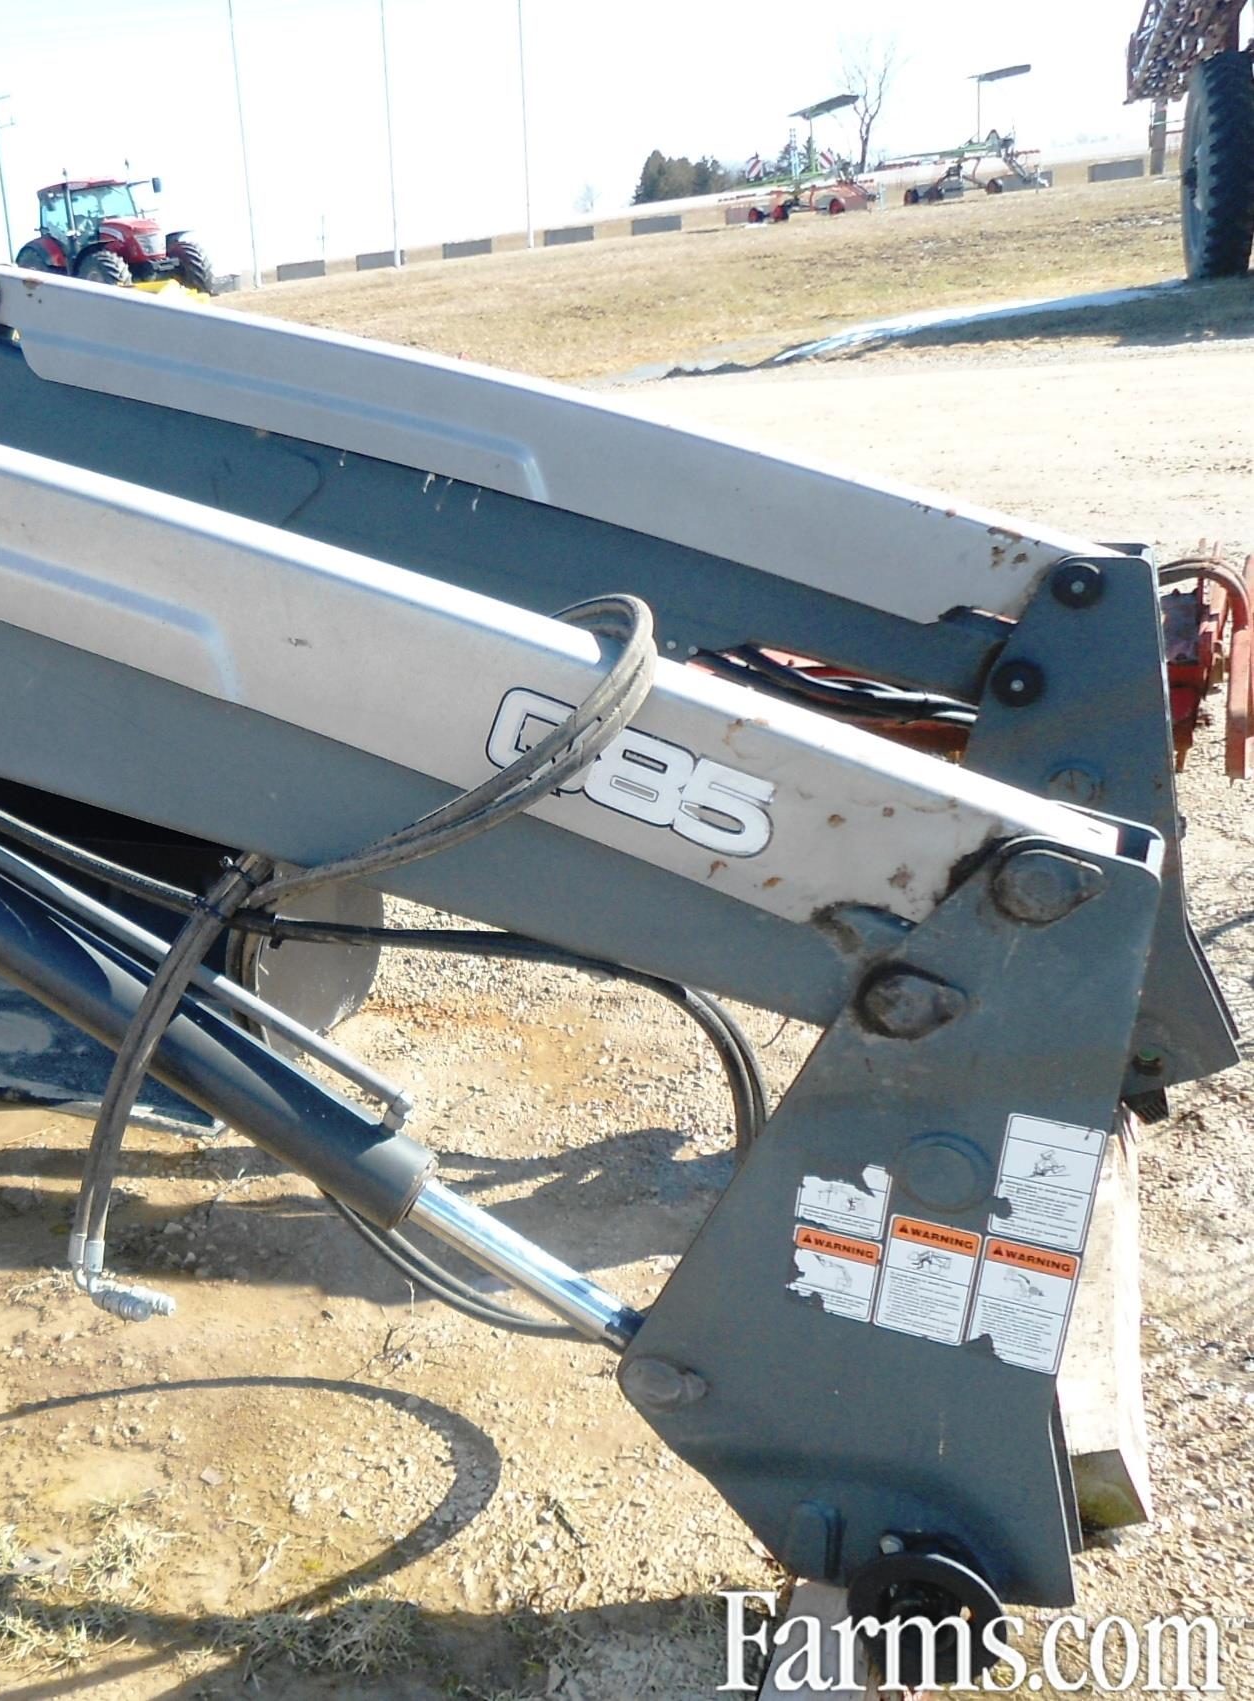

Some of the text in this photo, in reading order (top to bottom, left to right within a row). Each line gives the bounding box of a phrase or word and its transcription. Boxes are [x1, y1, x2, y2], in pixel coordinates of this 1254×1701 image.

[814, 1238, 874, 1259] WARNING
[910, 1227, 973, 1249] WARNING
[1006, 1251, 1071, 1272] WARNING
